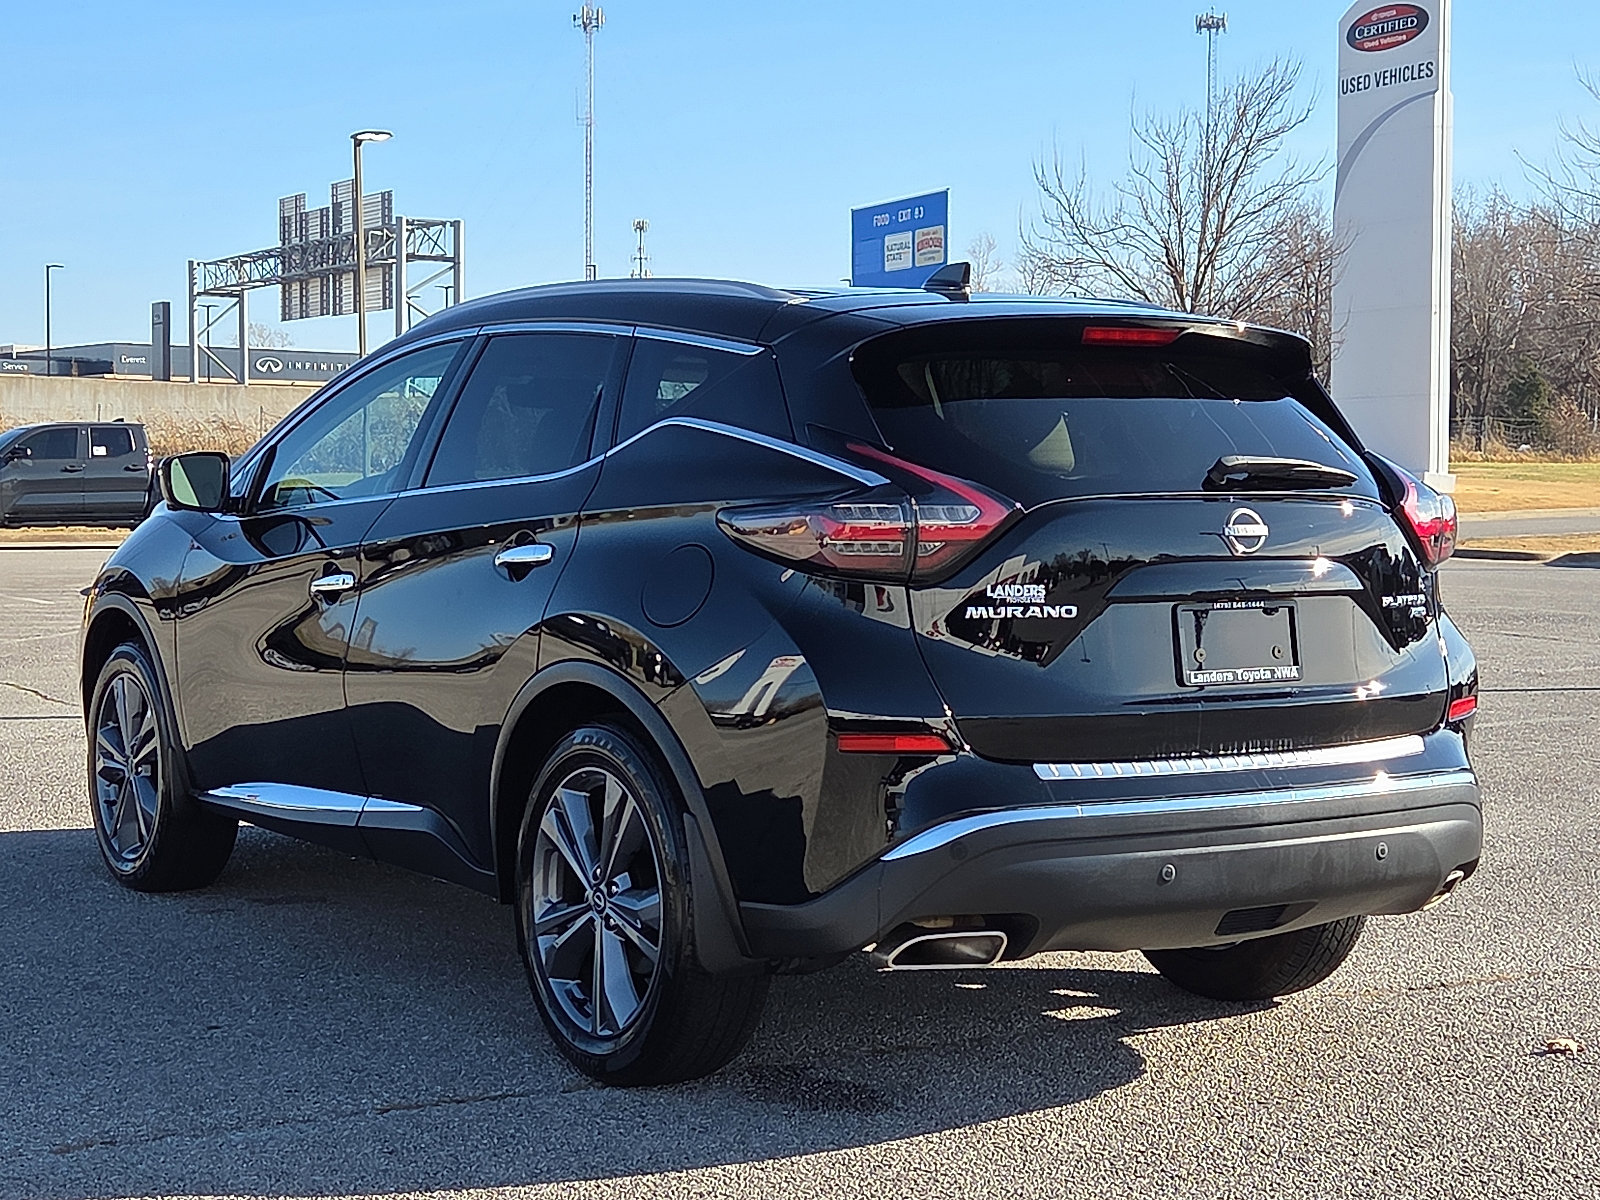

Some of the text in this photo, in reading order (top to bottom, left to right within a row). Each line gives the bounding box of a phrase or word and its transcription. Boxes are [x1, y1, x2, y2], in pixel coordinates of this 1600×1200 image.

[1355, 16, 1418, 40] CERTIFIED
[1341, 61, 1434, 95] USED VEHICLES
[873, 213, 890, 227] FOOD
[886, 240, 911, 252] NATURAL
[886, 252, 902, 262] STATE
[121, 354, 146, 364] Everett
[2, 362, 28, 371] Service
[986, 584, 1046, 598] LANDERS
[964, 605, 1078, 619] MURANO
[1190, 666, 1299, 683] Landers Toyota NWA
